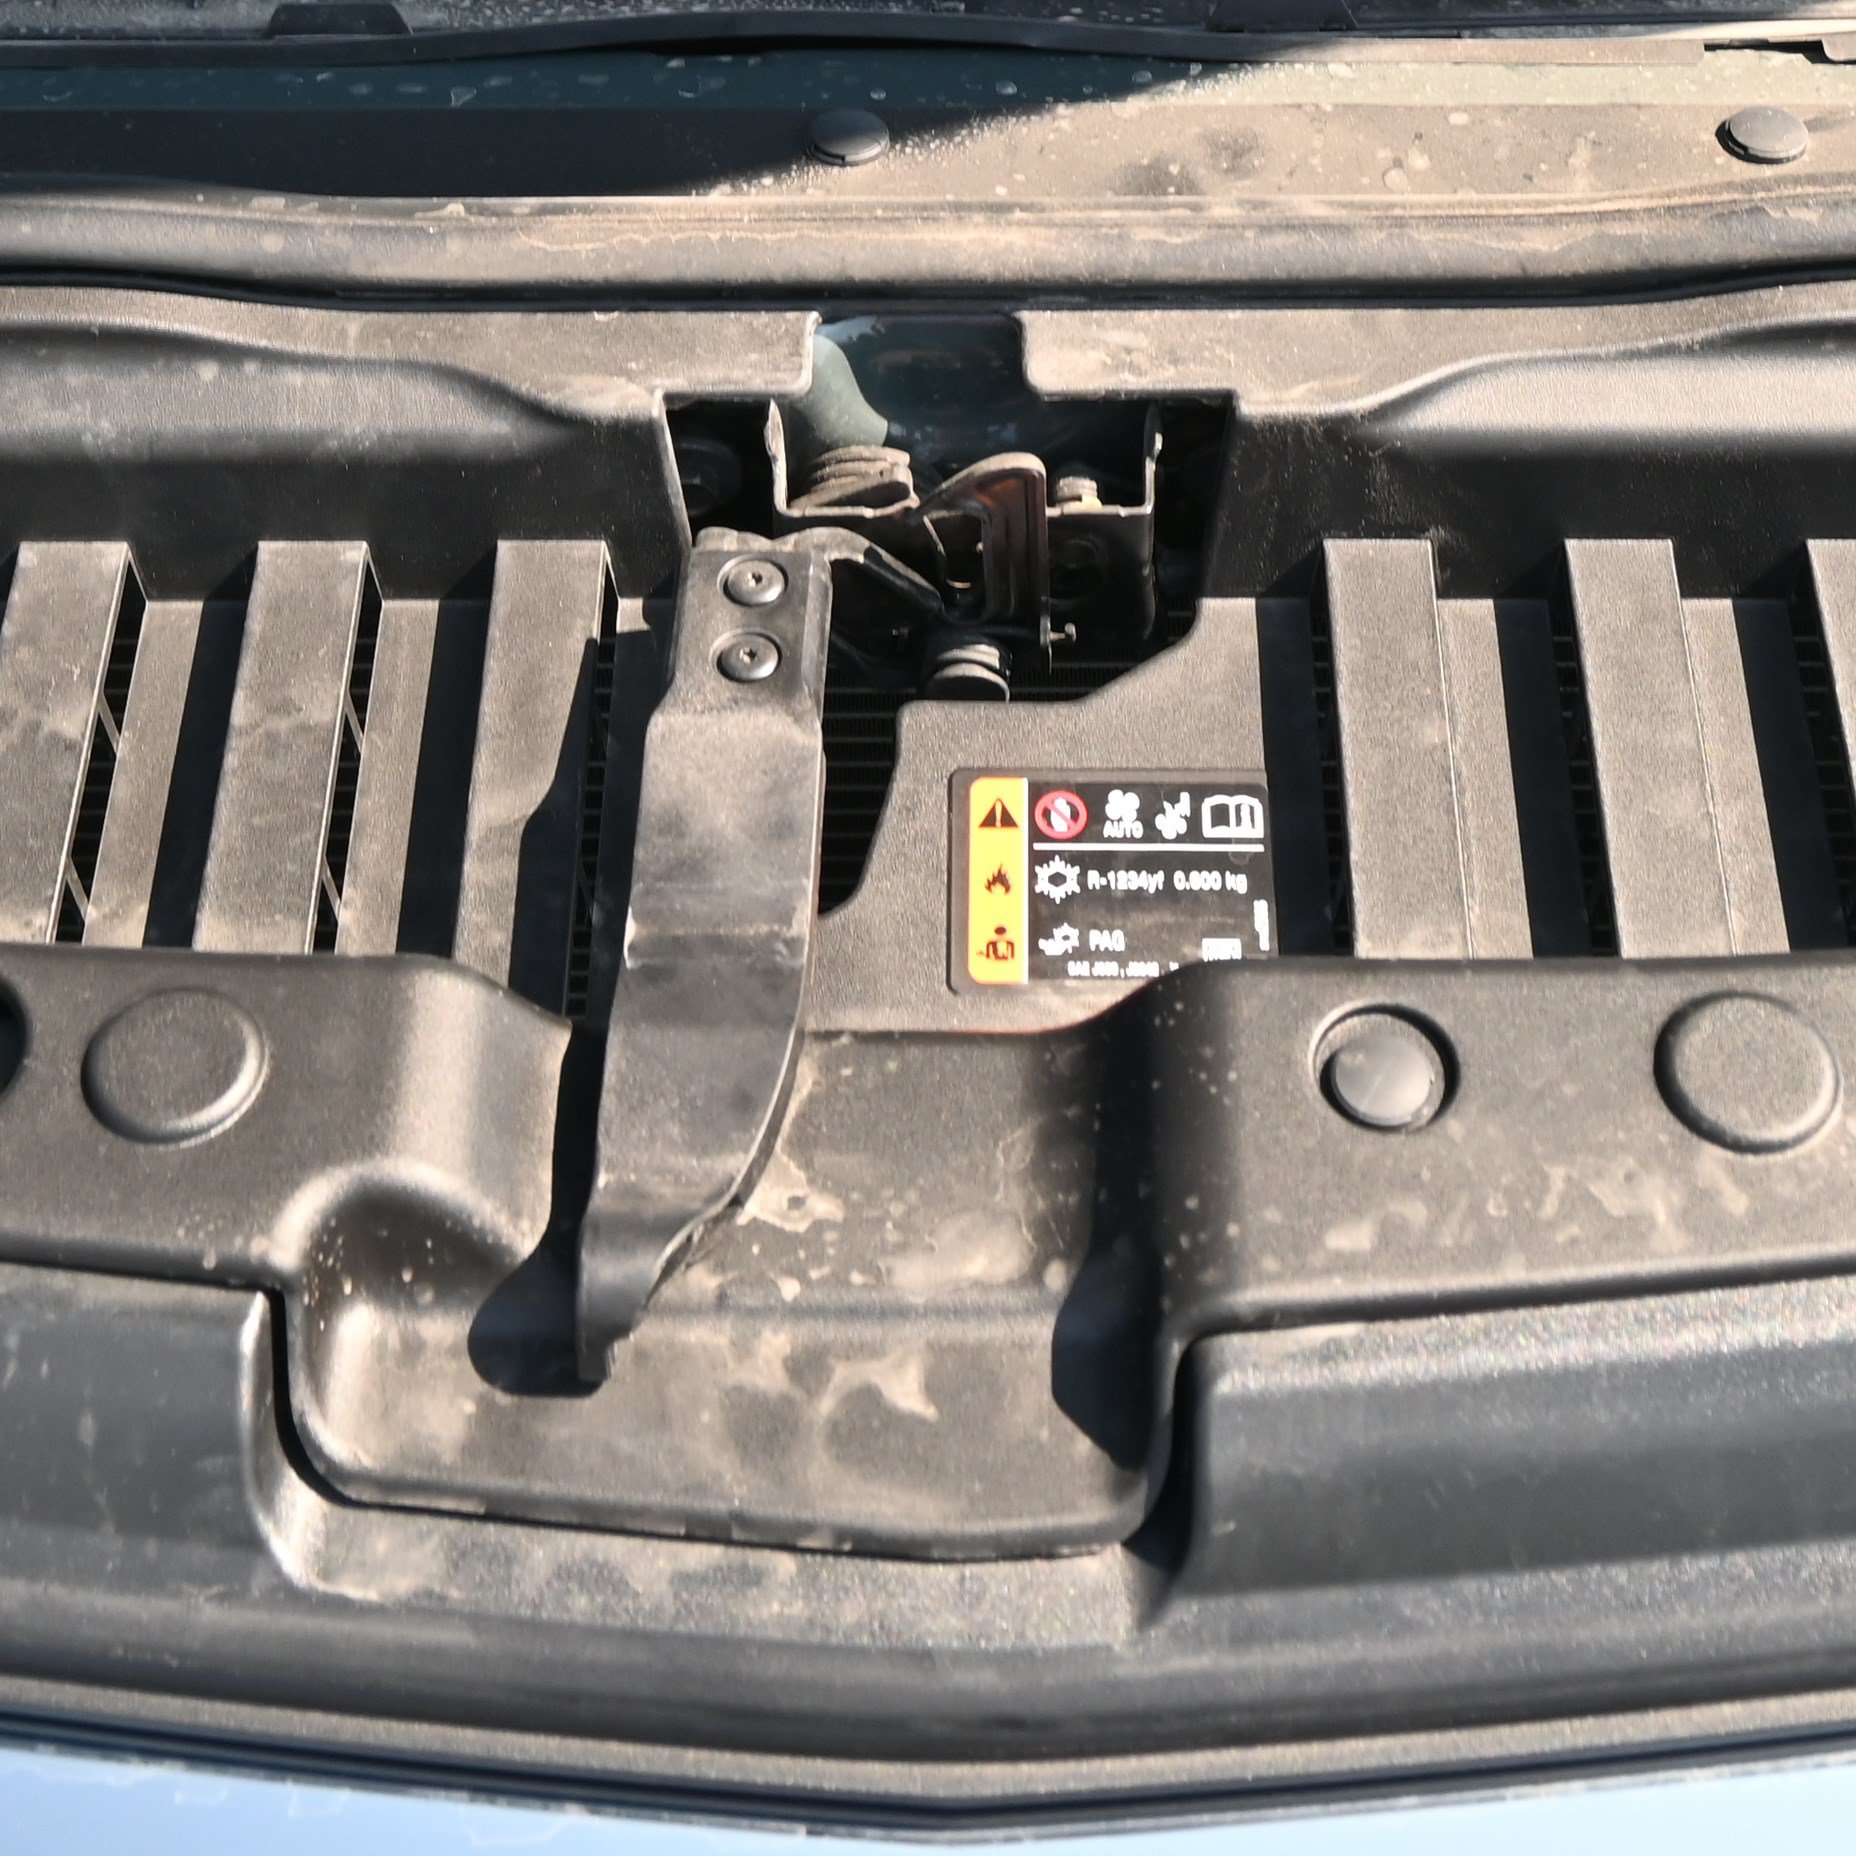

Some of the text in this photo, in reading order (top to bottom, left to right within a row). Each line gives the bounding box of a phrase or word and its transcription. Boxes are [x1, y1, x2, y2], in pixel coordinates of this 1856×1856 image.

[1104, 821, 1144, 839] AUTO
[1088, 870, 1164, 894] R-1234yf
[1225, 871, 1248, 894] kg
[1089, 930, 1126, 952] PAG
